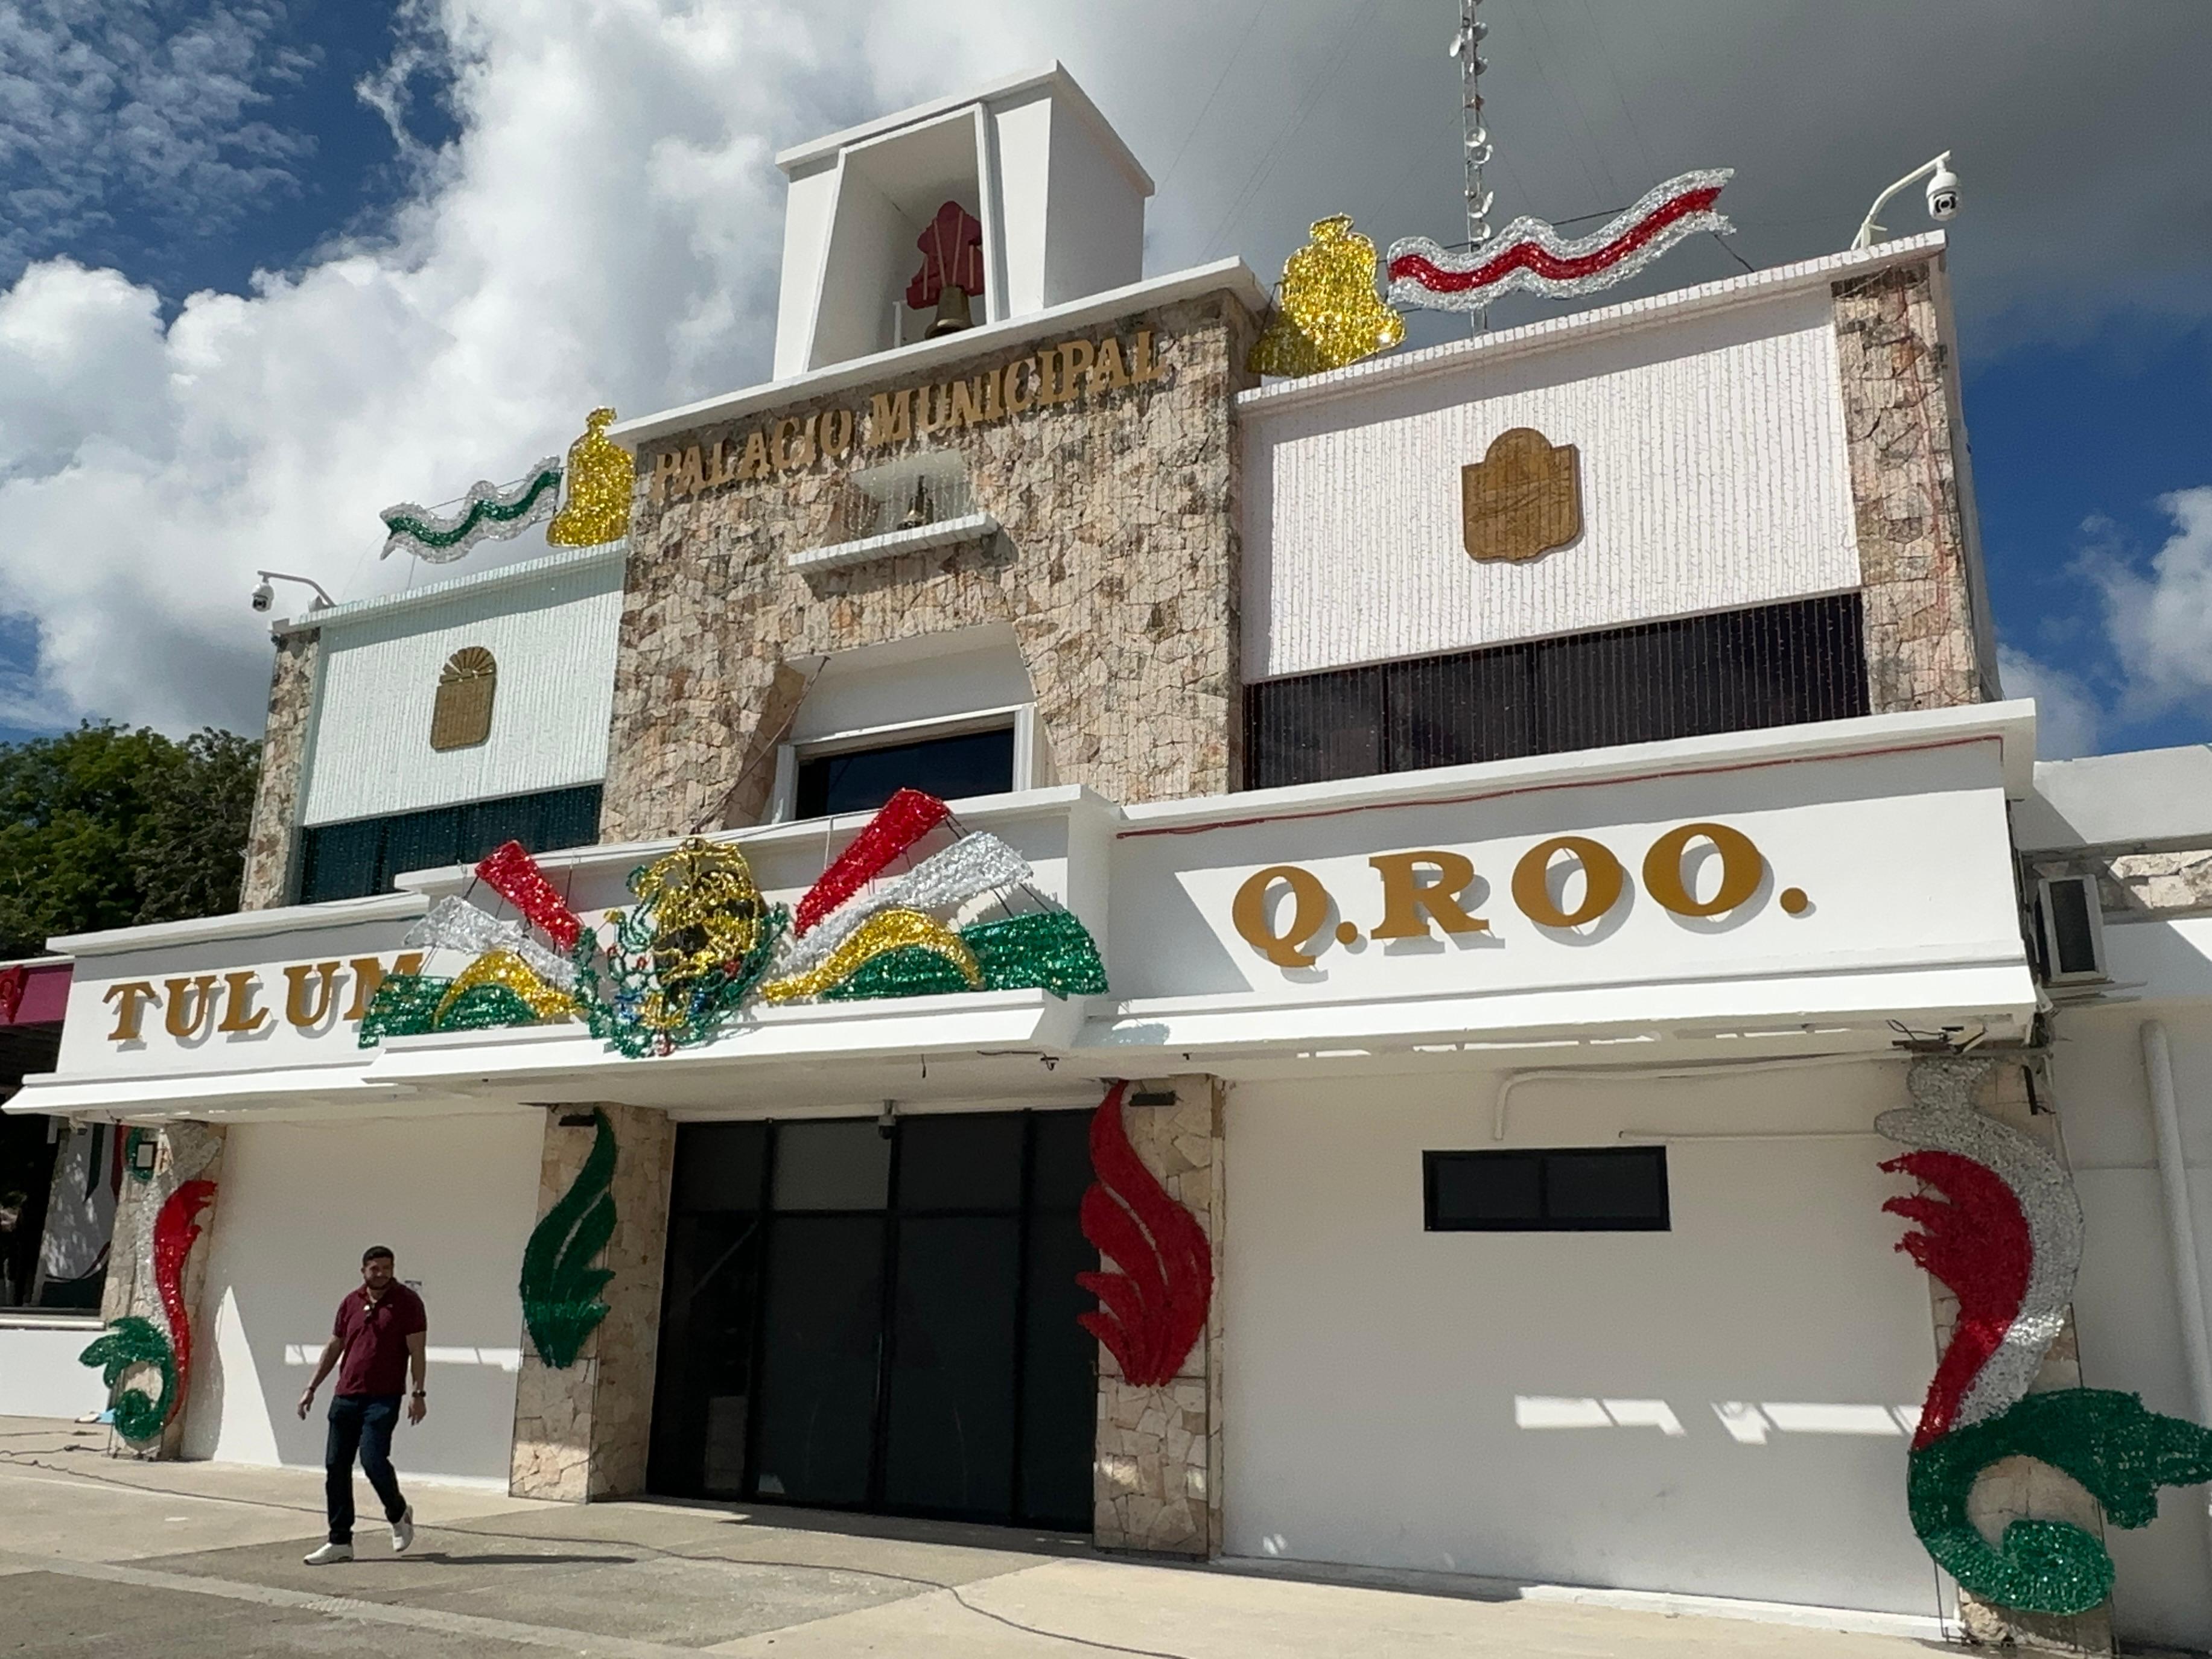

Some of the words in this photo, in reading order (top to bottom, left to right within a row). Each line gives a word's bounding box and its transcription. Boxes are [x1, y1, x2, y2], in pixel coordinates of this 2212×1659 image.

[648, 409, 853, 503] PALACIO
[867, 330, 1167, 448] MUNICIPAL
[1232, 823, 1808, 968] Q.ROO.
